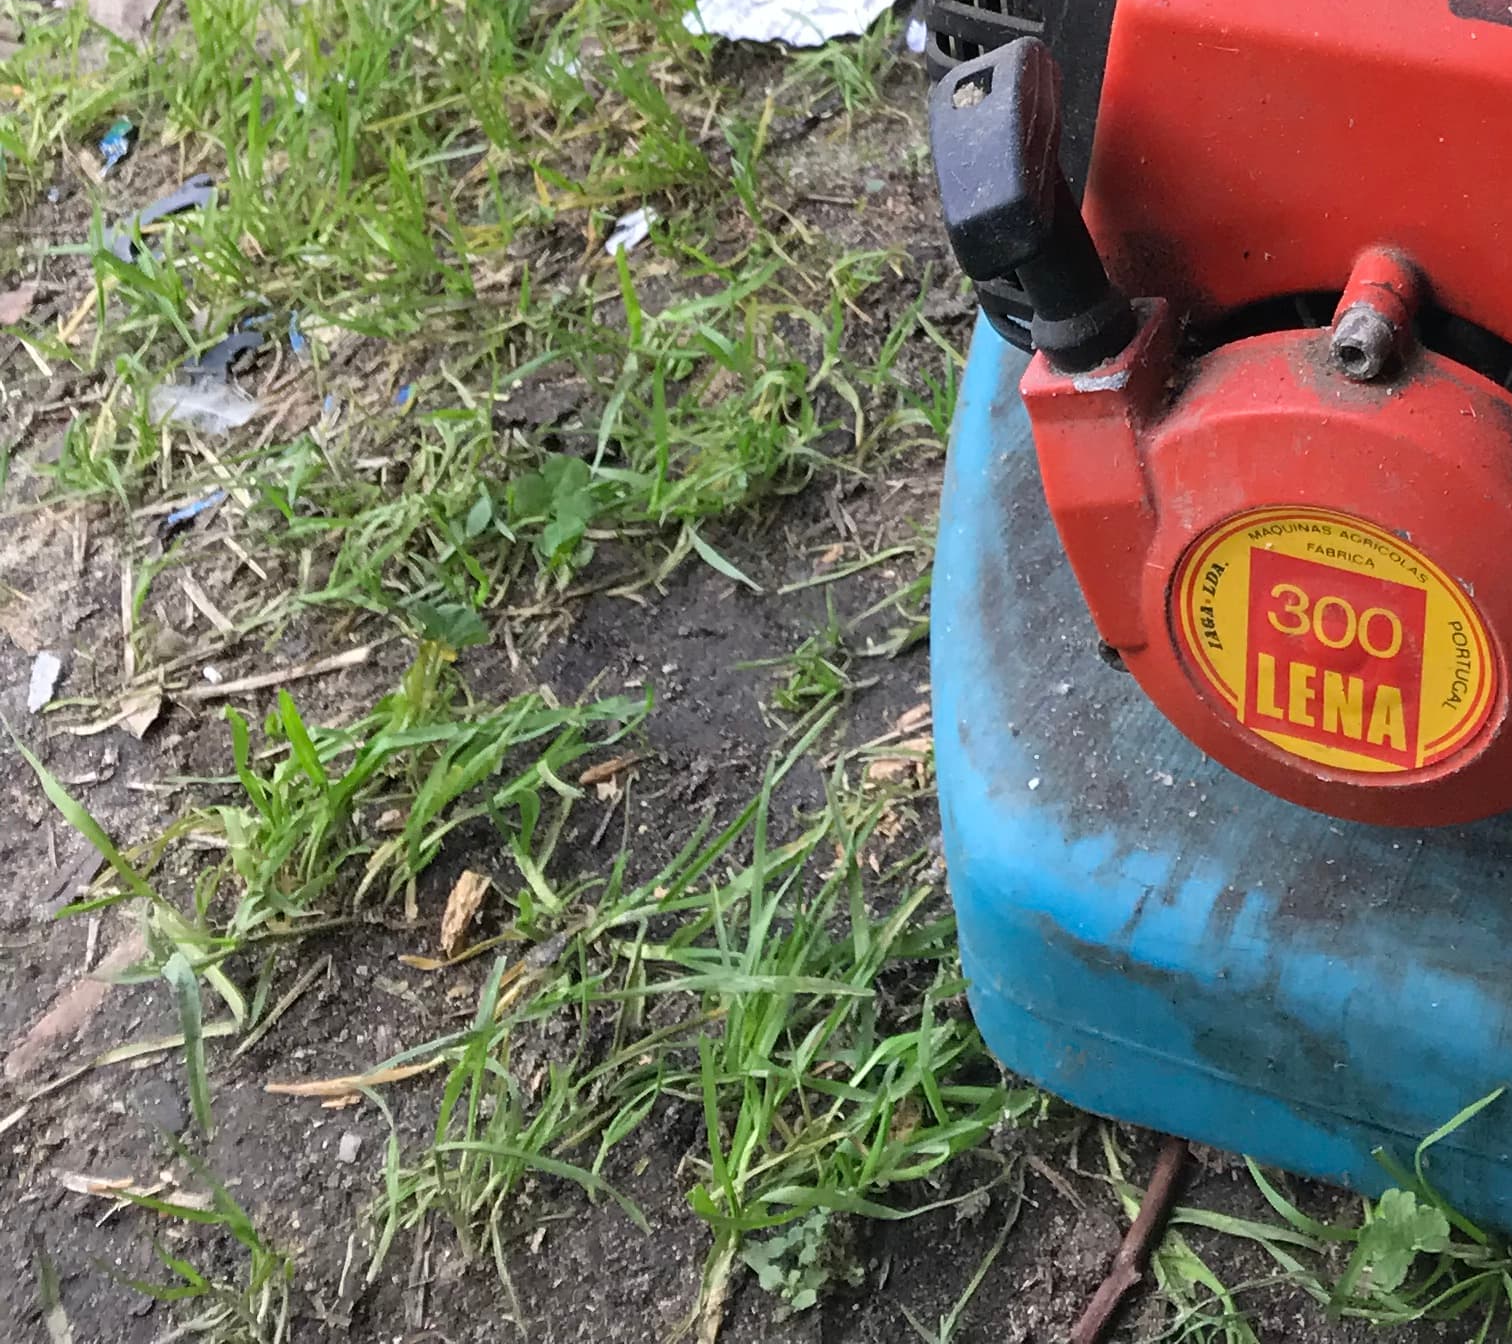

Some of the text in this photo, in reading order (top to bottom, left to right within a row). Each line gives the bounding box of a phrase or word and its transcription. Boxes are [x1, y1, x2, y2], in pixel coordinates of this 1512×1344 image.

[1248, 523, 1428, 584] MAQUINAS AGRICOLAS
[1306, 542, 1375, 569] FABRICA
[1266, 583, 1403, 659] 300
[1256, 652, 1408, 752] LENA
[1441, 620, 1471, 710] PORTUGAL
